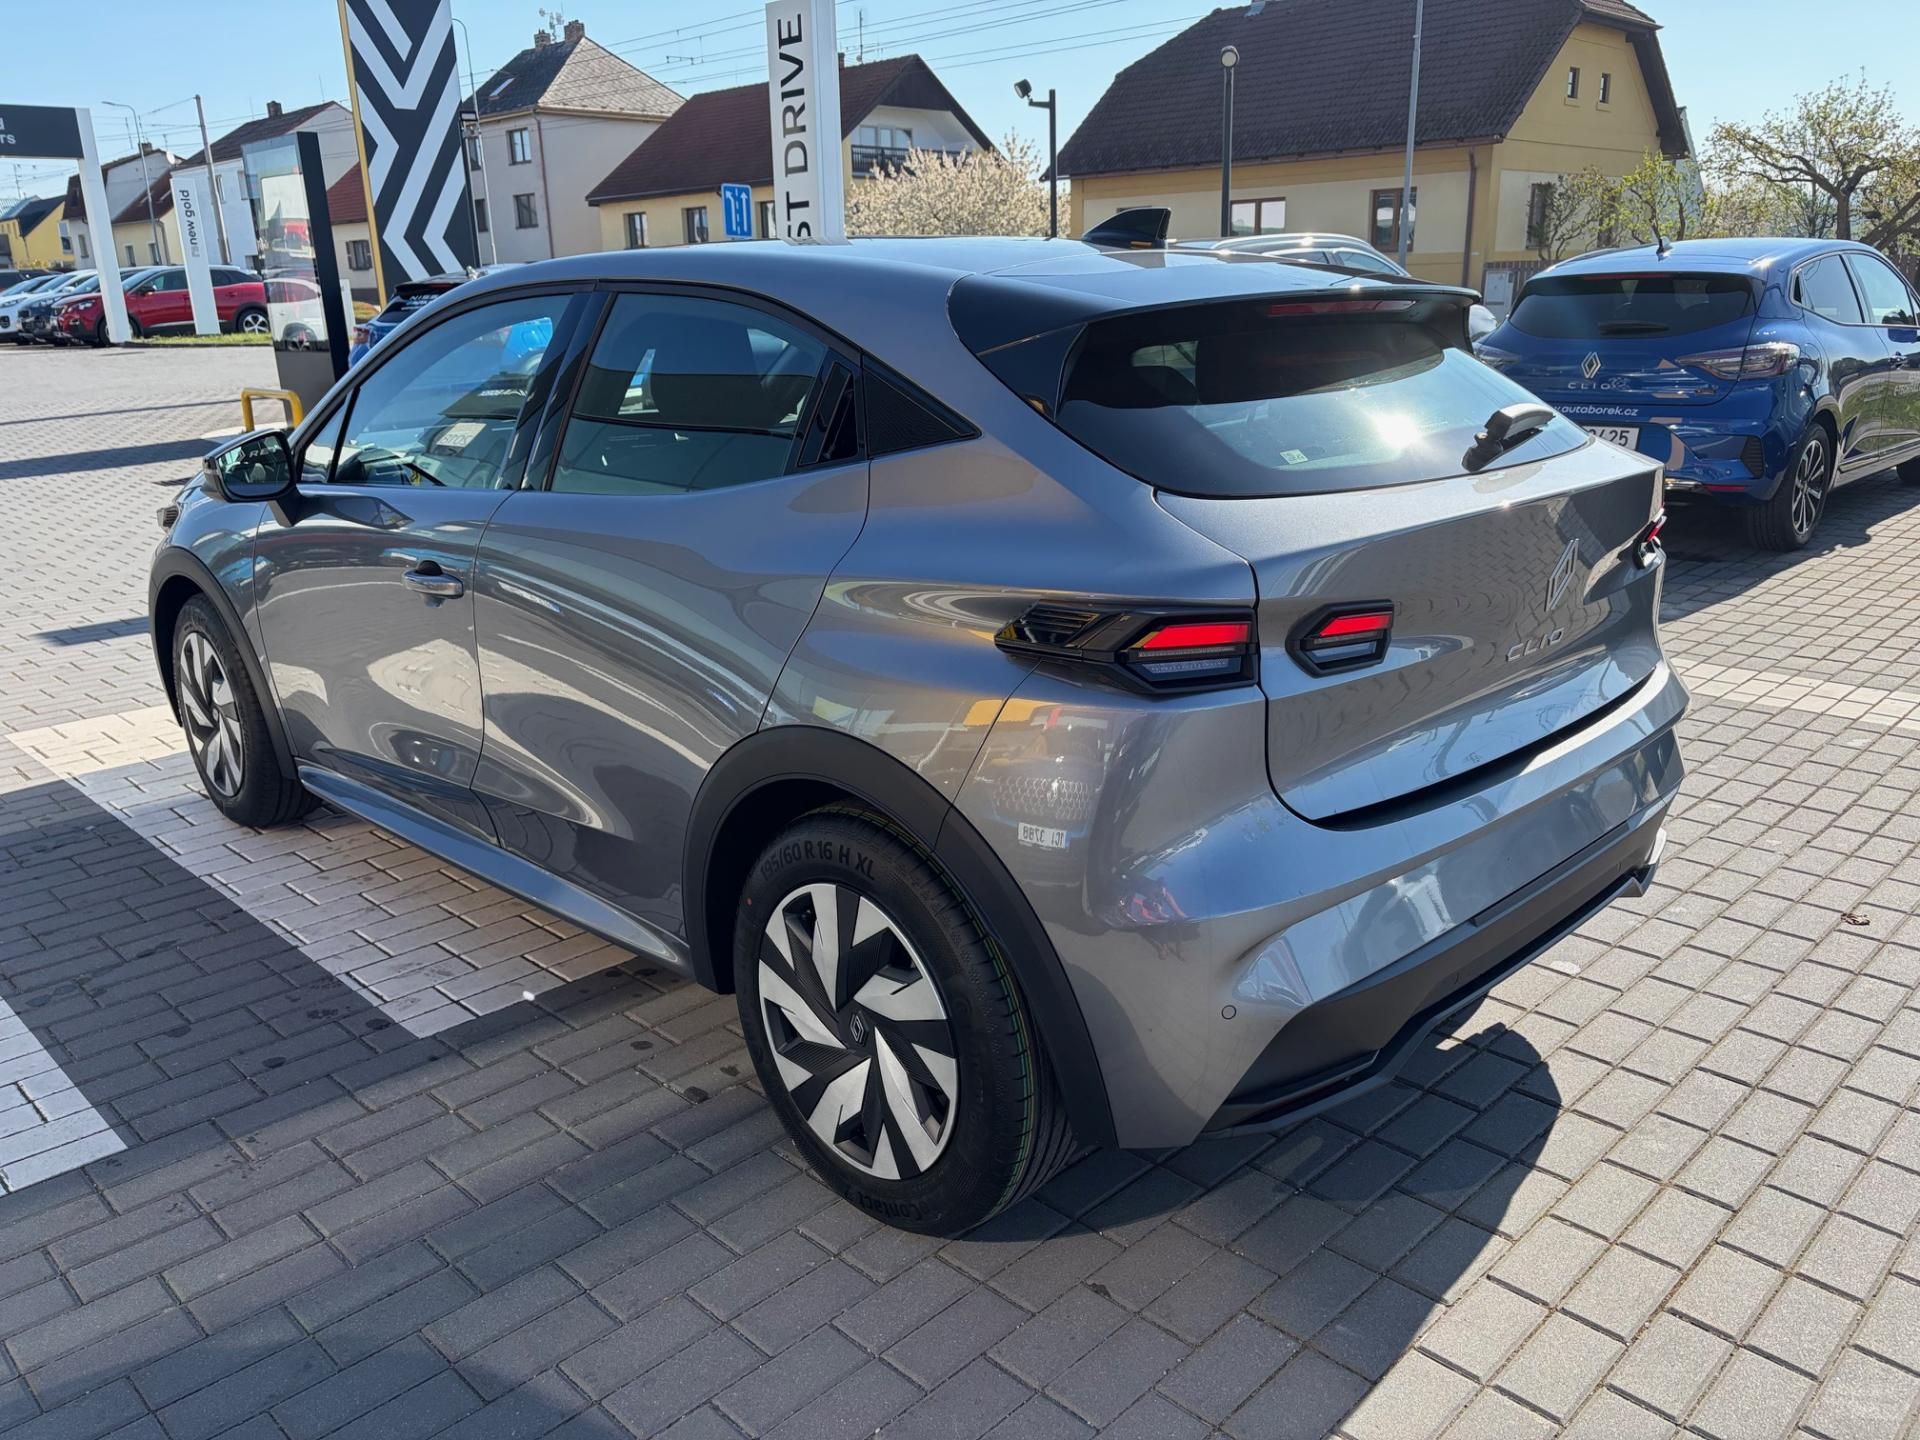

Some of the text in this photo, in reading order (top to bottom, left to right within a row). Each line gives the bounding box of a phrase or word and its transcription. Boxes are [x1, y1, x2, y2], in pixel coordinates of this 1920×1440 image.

[777, 14, 808, 178] DRIVE
[179, 189, 195, 218] gold
[1567, 382, 1611, 390] CLIO
[1505, 628, 1565, 662] CLIO
[760, 842, 801, 881] 195/60
[838, 843, 851, 866] H
[854, 851, 875, 881] XL
